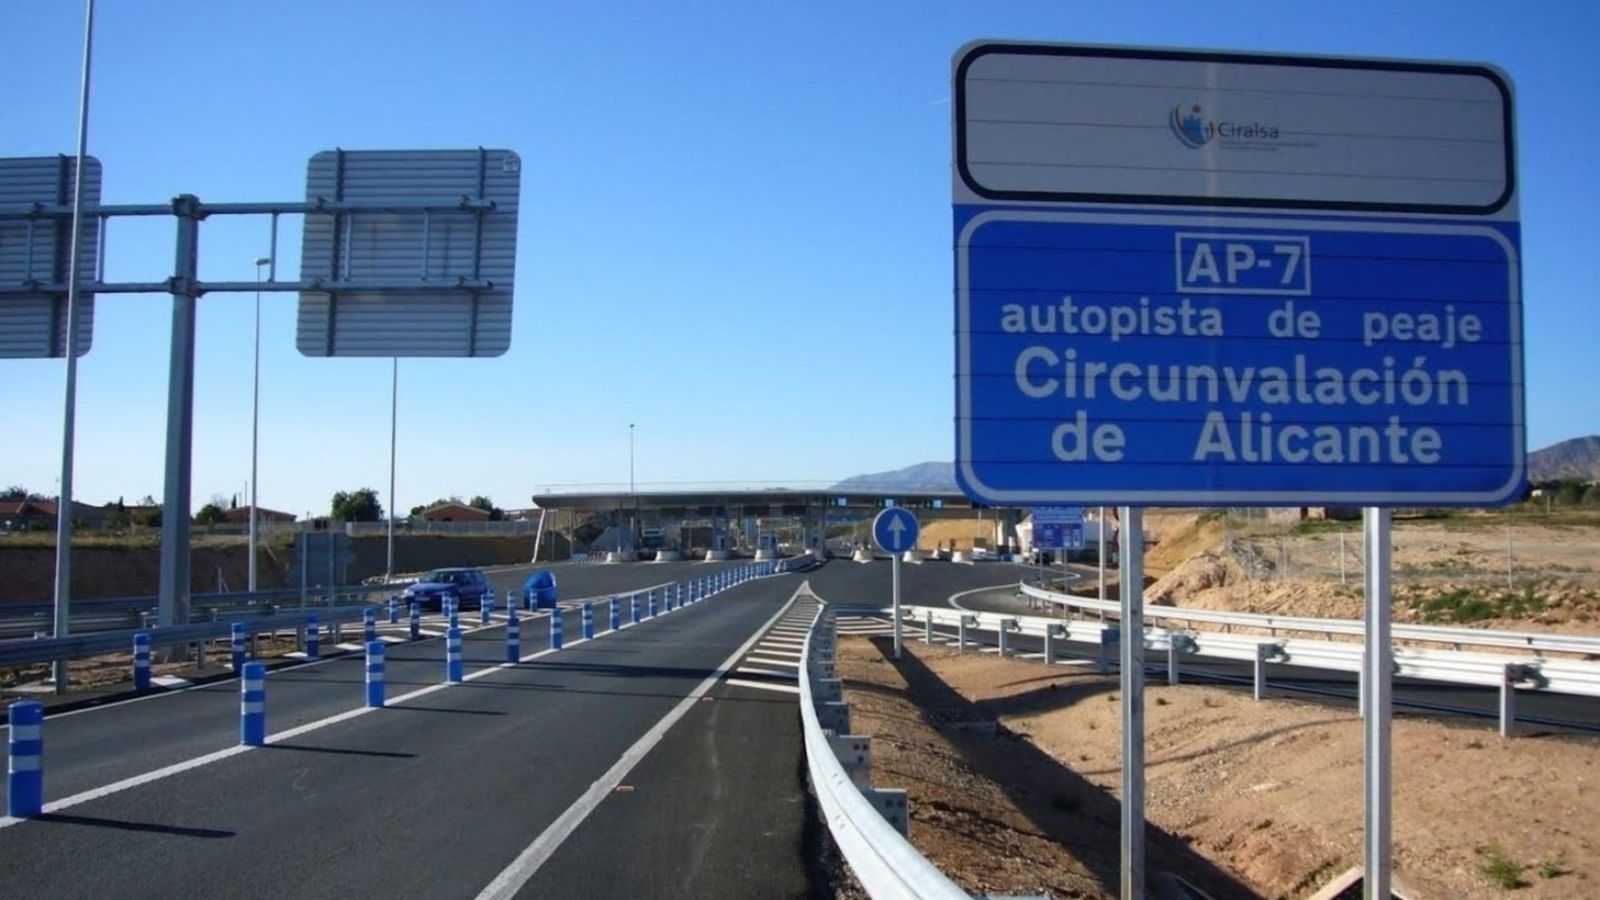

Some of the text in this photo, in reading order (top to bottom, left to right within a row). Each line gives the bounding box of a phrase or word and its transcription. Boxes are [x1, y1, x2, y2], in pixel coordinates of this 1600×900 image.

[1218, 121, 1280, 139] Ciralsa
[1186, 243, 1302, 284] AP-7
[1001, 297, 1483, 348] autopista de peaje
[1014, 346, 1469, 405] Circunvalación
[1051, 410, 1442, 464] de Alicante
